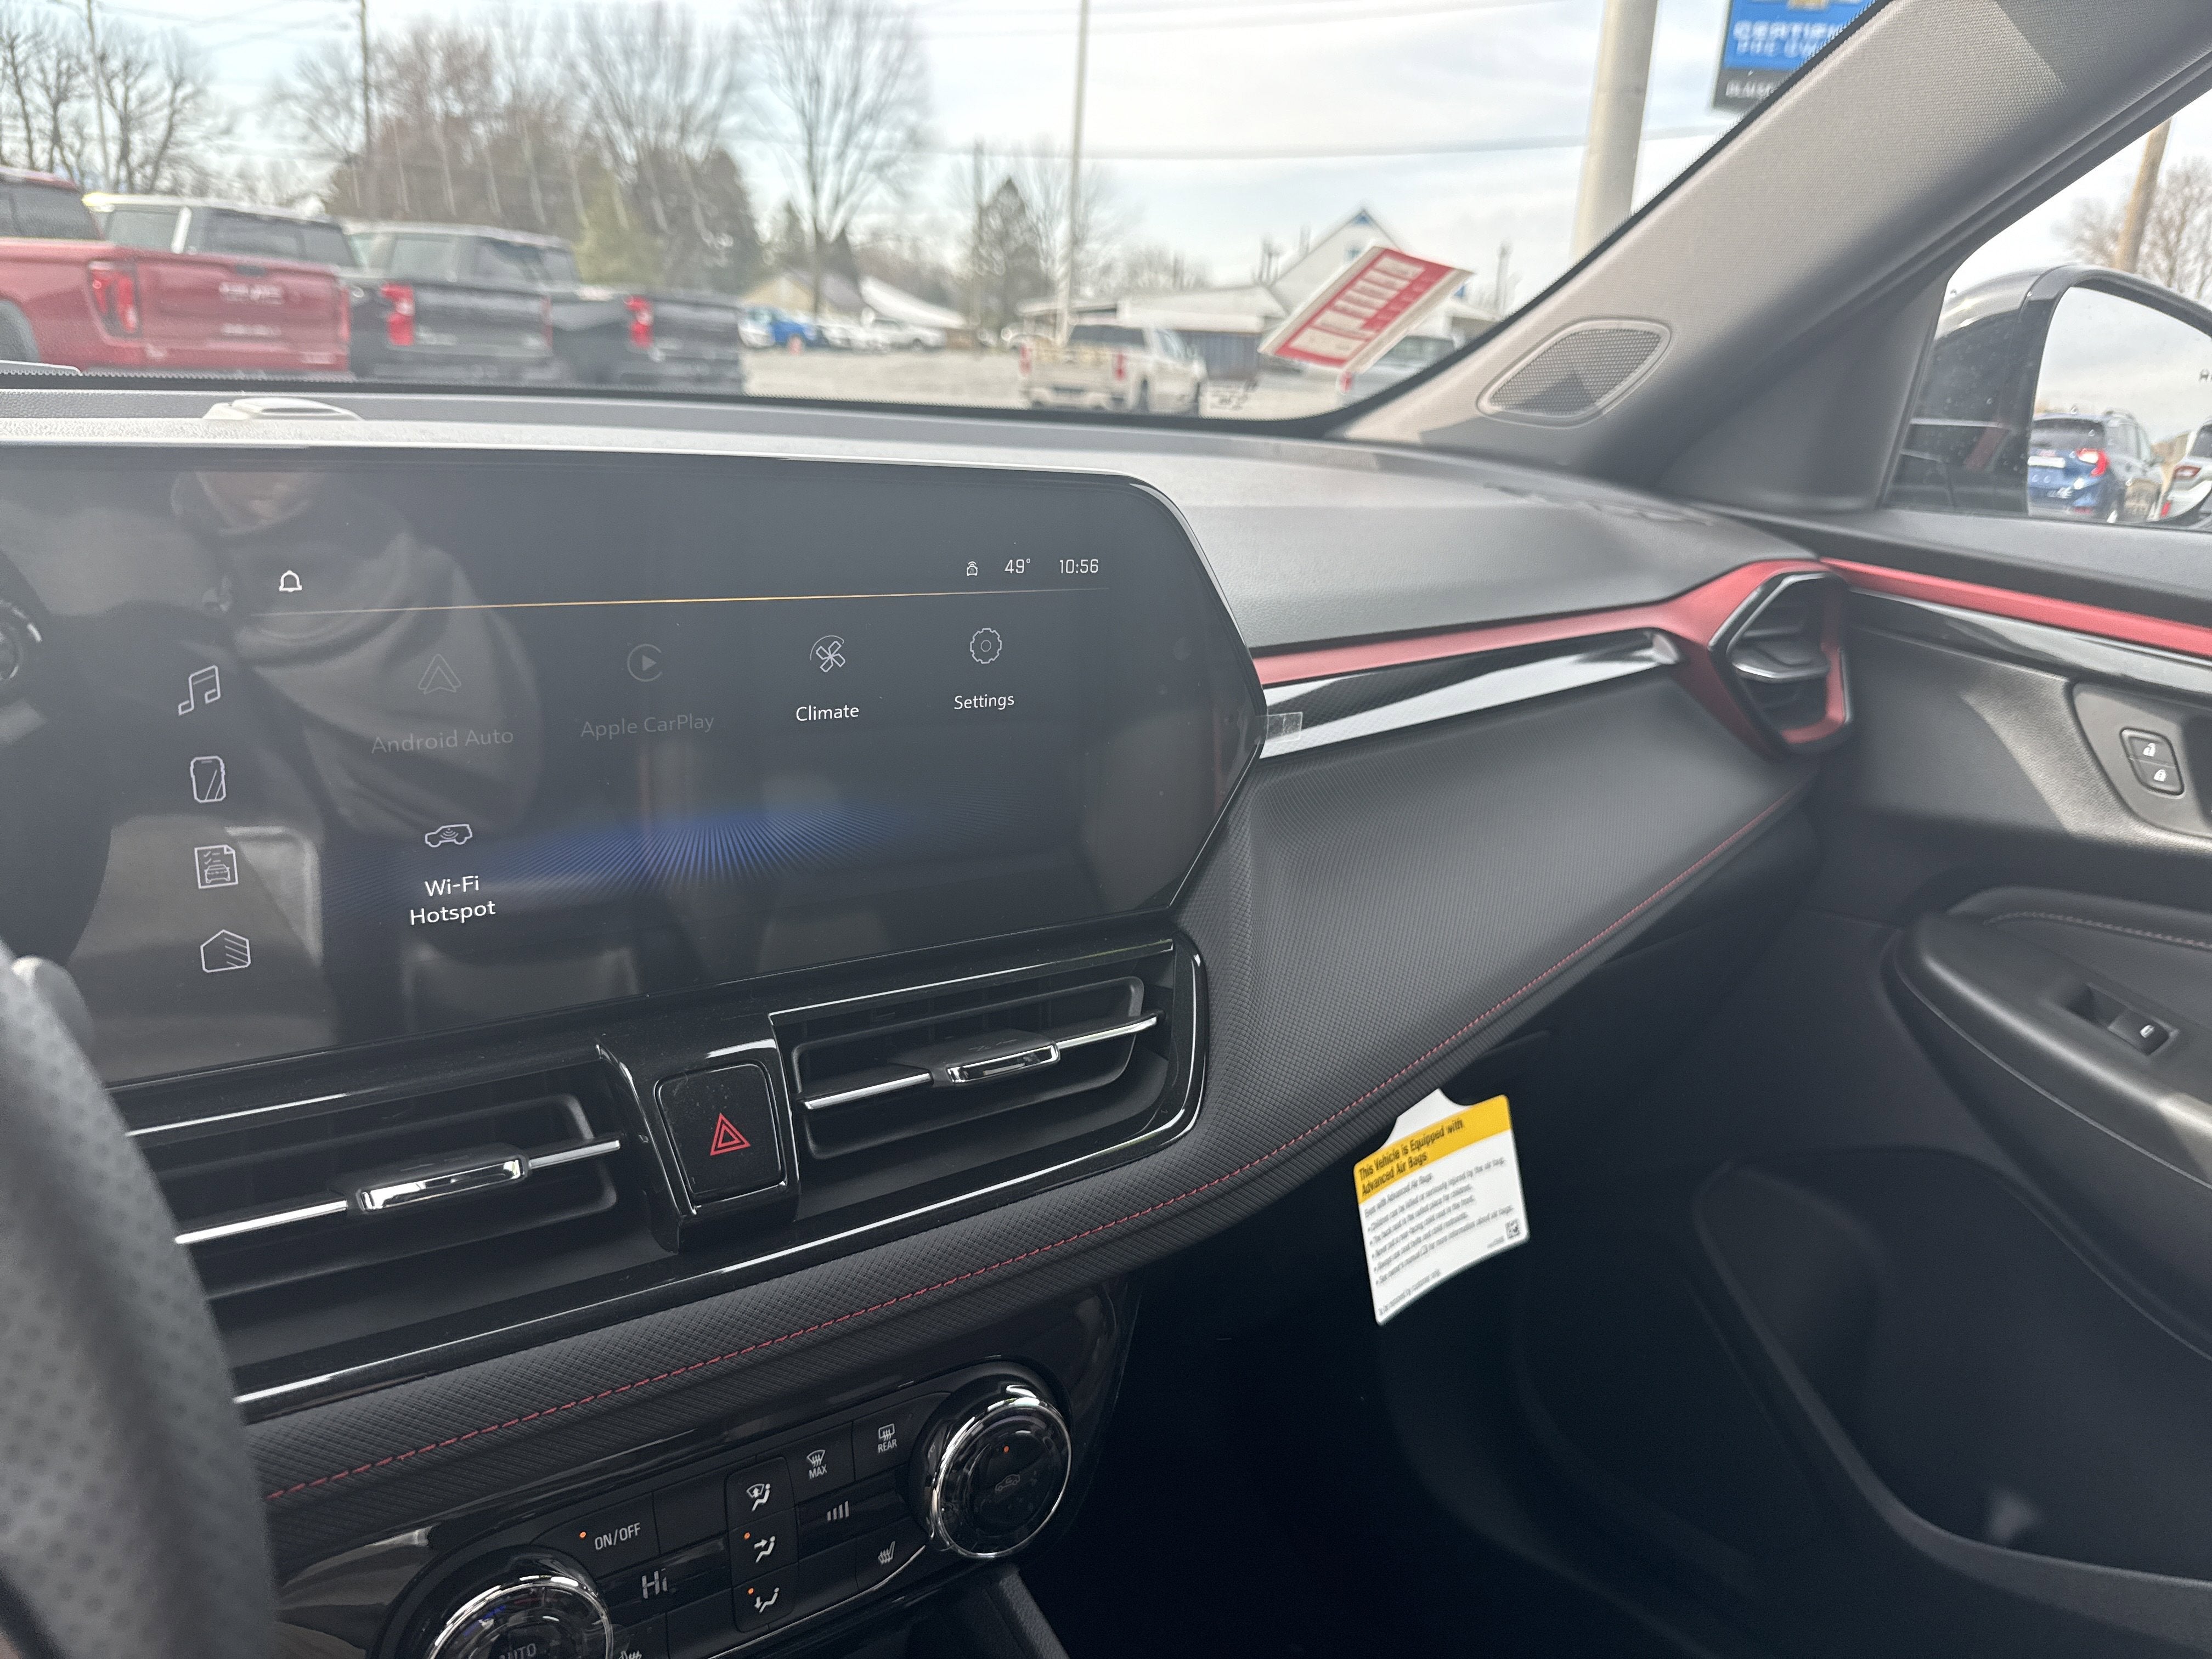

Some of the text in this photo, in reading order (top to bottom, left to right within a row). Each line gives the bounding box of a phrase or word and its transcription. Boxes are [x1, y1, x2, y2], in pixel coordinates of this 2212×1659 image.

[1059, 558, 1099, 573] 10:56
[795, 704, 860, 723] Climate
[953, 693, 1015, 711] Settings
[580, 713, 715, 739] Apple CarPlay
[371, 727, 514, 755] Android Auto
[425, 875, 481, 898] Wi-Fi
[410, 901, 496, 926] Hotspot
[1358, 1119, 1463, 1181] This Vehicle is Equipped with
[1361, 1151, 1427, 1195] Advanced Air Bags
[878, 1439, 897, 1453] REAR
[809, 1465, 827, 1480] MAX
[595, 1523, 641, 1550] ON/OFF
